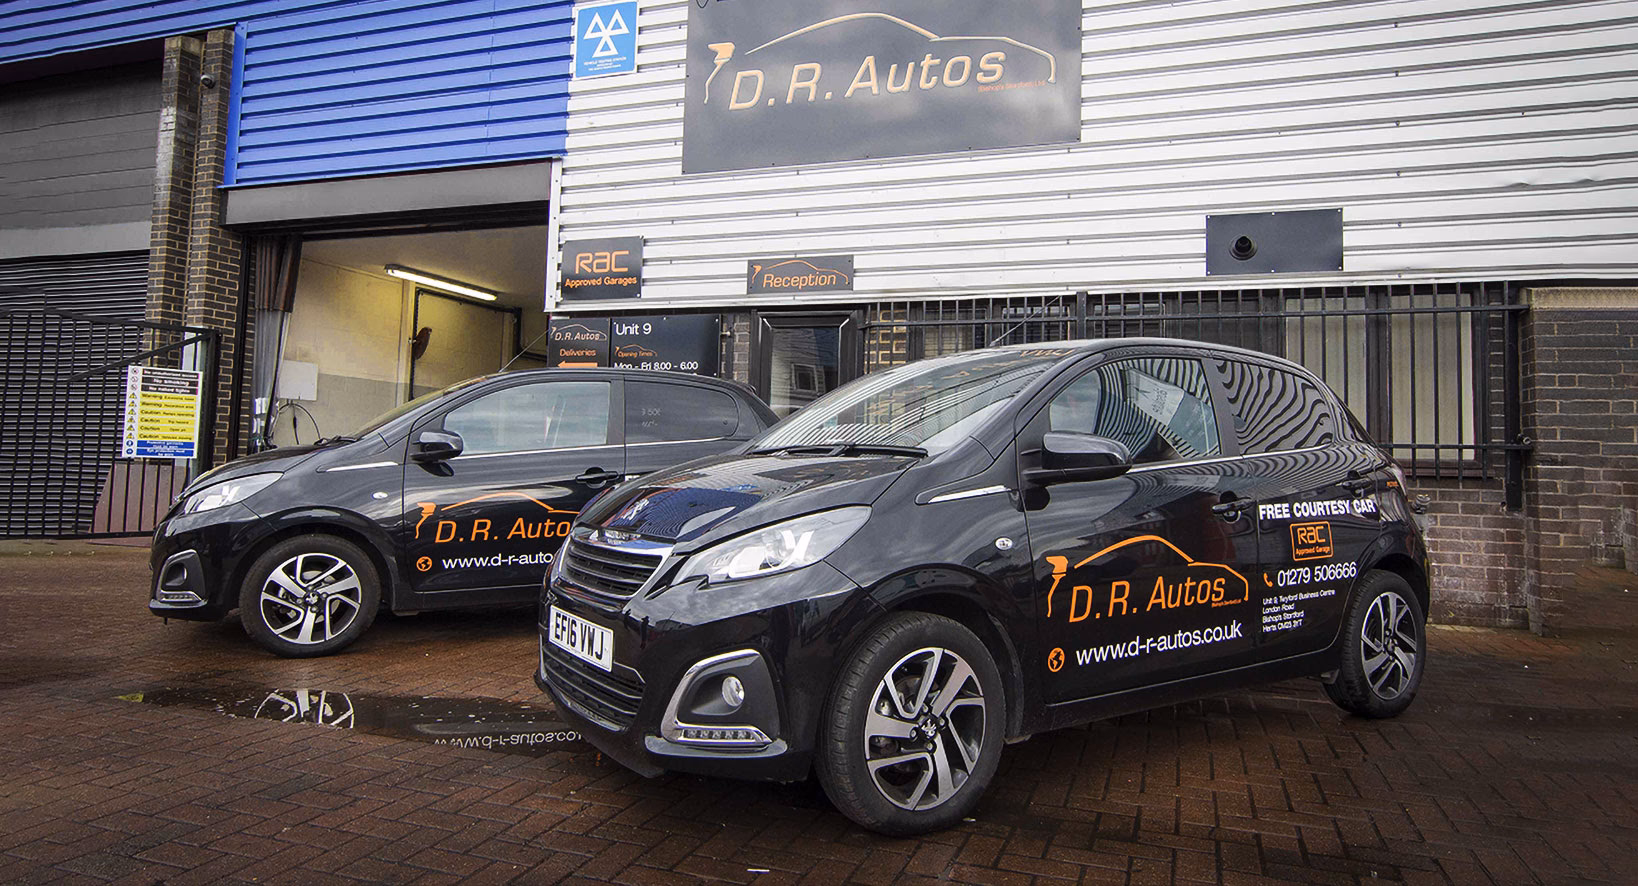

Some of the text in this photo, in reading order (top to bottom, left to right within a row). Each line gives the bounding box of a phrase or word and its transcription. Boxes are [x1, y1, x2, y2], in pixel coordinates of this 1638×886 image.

[844, 50, 1007, 99] Autos
[564, 276, 637, 288] Approved Garages
[762, 271, 837, 290] Reception
[615, 322, 652, 336] Unit 9
[559, 348, 597, 357] Deliveries
[680, 361, 699, 370] 6.00
[1258, 498, 1377, 520] FREE COURTESY CAR
[506, 516, 571, 540] Auto
[441, 551, 554, 570] www.d-r-auto
[1277, 561, 1357, 587] 01279 506666
[1145, 574, 1227, 612] Autos
[1298, 590, 1319, 600] Business
[1262, 603, 1295, 614] London Road
[554, 611, 577, 648] EF16
[1075, 618, 1243, 667] www.d-r-autos.co.uk
